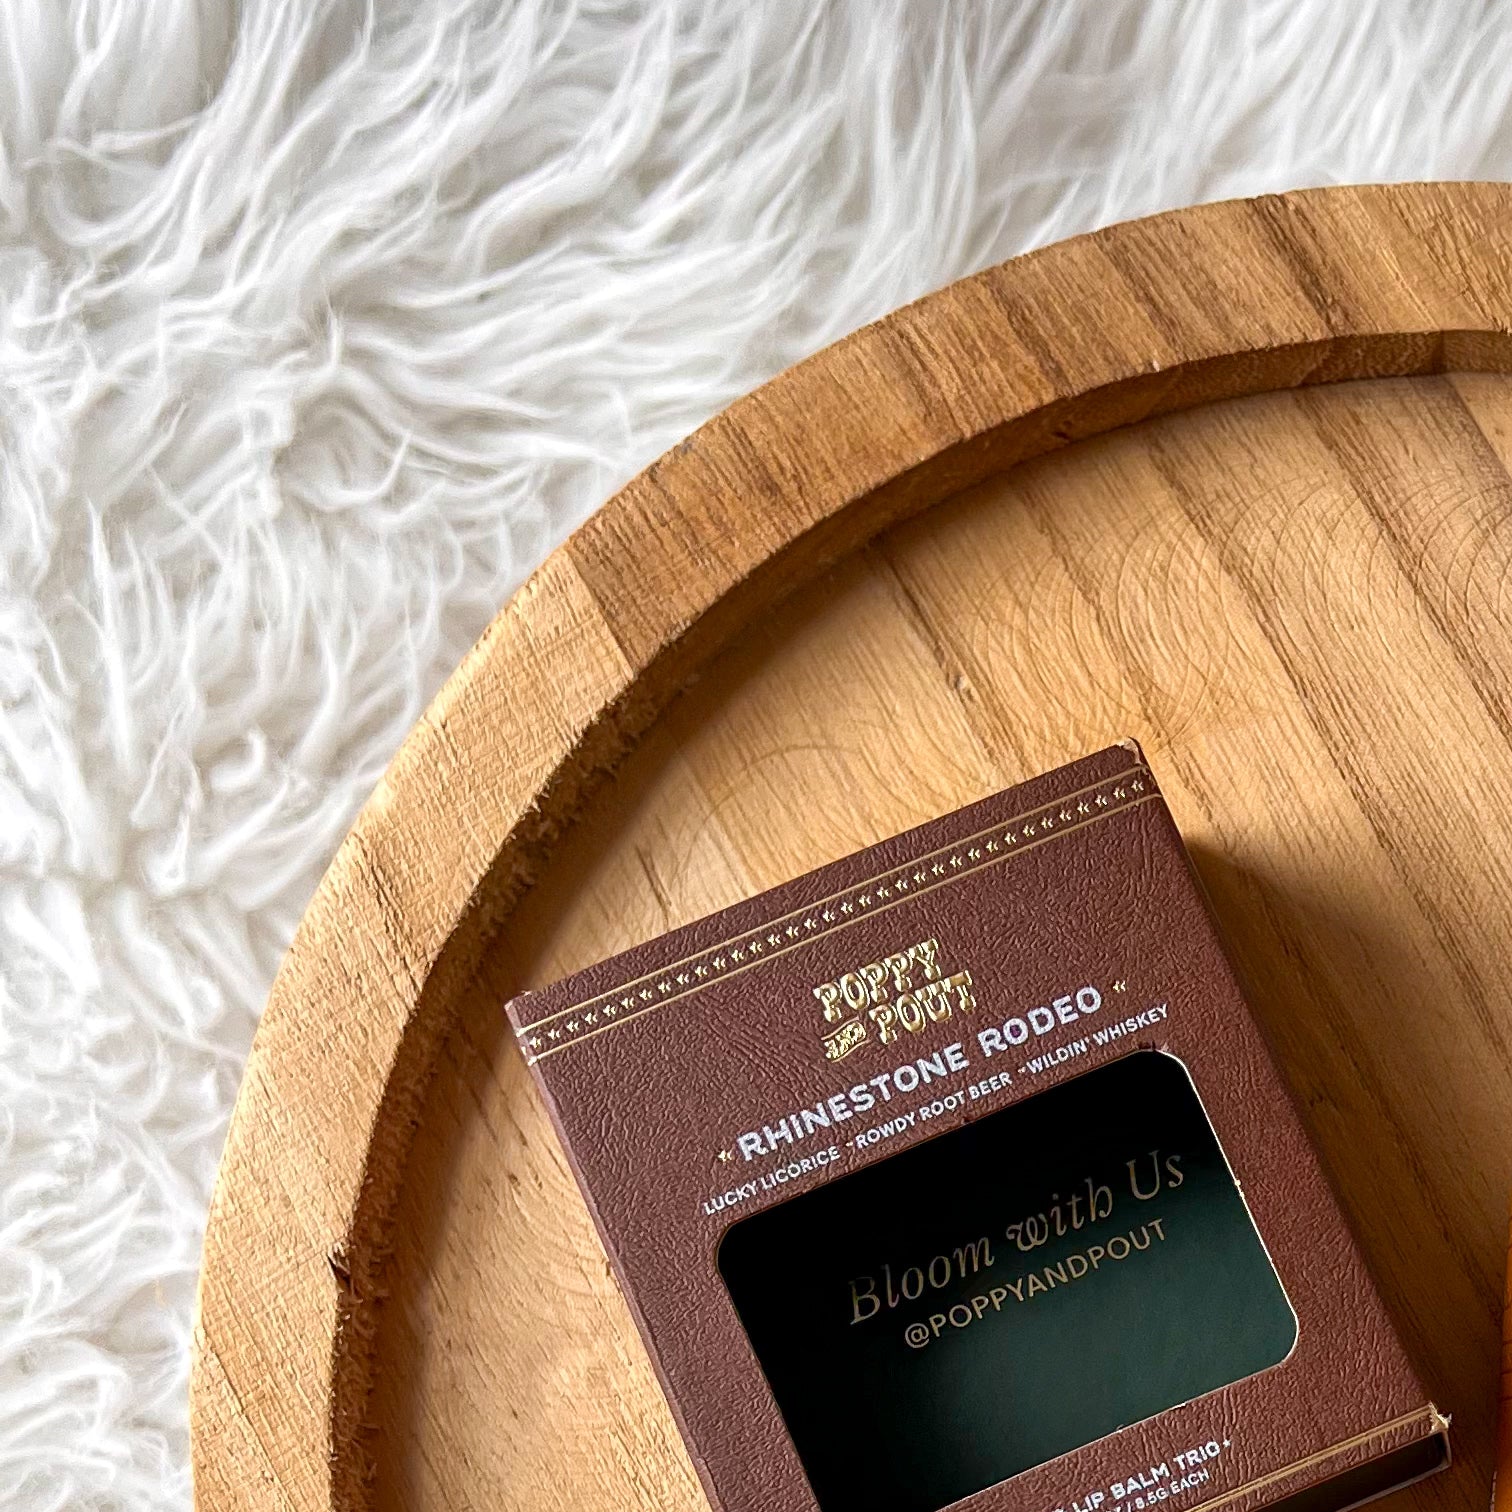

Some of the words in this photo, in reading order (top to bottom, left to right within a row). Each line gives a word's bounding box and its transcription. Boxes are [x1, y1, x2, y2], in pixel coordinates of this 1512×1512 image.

[813, 938, 939, 1022] POPPY
[869, 970, 977, 1044] POUT
[737, 1043, 970, 1161] RHINESTONE
[977, 986, 1102, 1057] RODEO
[1026, 1038, 1091, 1075] WILDIN'
[1092, 1004, 1169, 1046] WHISKEY
[856, 1115, 917, 1150] ROWDY
[919, 1095, 966, 1120] ROOT
[968, 1071, 1012, 1100] BEER
[704, 1181, 759, 1215] LUCKY
[761, 1148, 840, 1190] LICORICE
[848, 1236, 995, 1325] Bloom
[1006, 1177, 1113, 1251] with
[1126, 1151, 1184, 1200] Us
[904, 1218, 1166, 1349] @POPPYANDPOUT
[1110, 1463, 1170, 1500] BALM
[1173, 1441, 1220, 1470] TRIO
[1171, 1468, 1209, 1494] EACH
